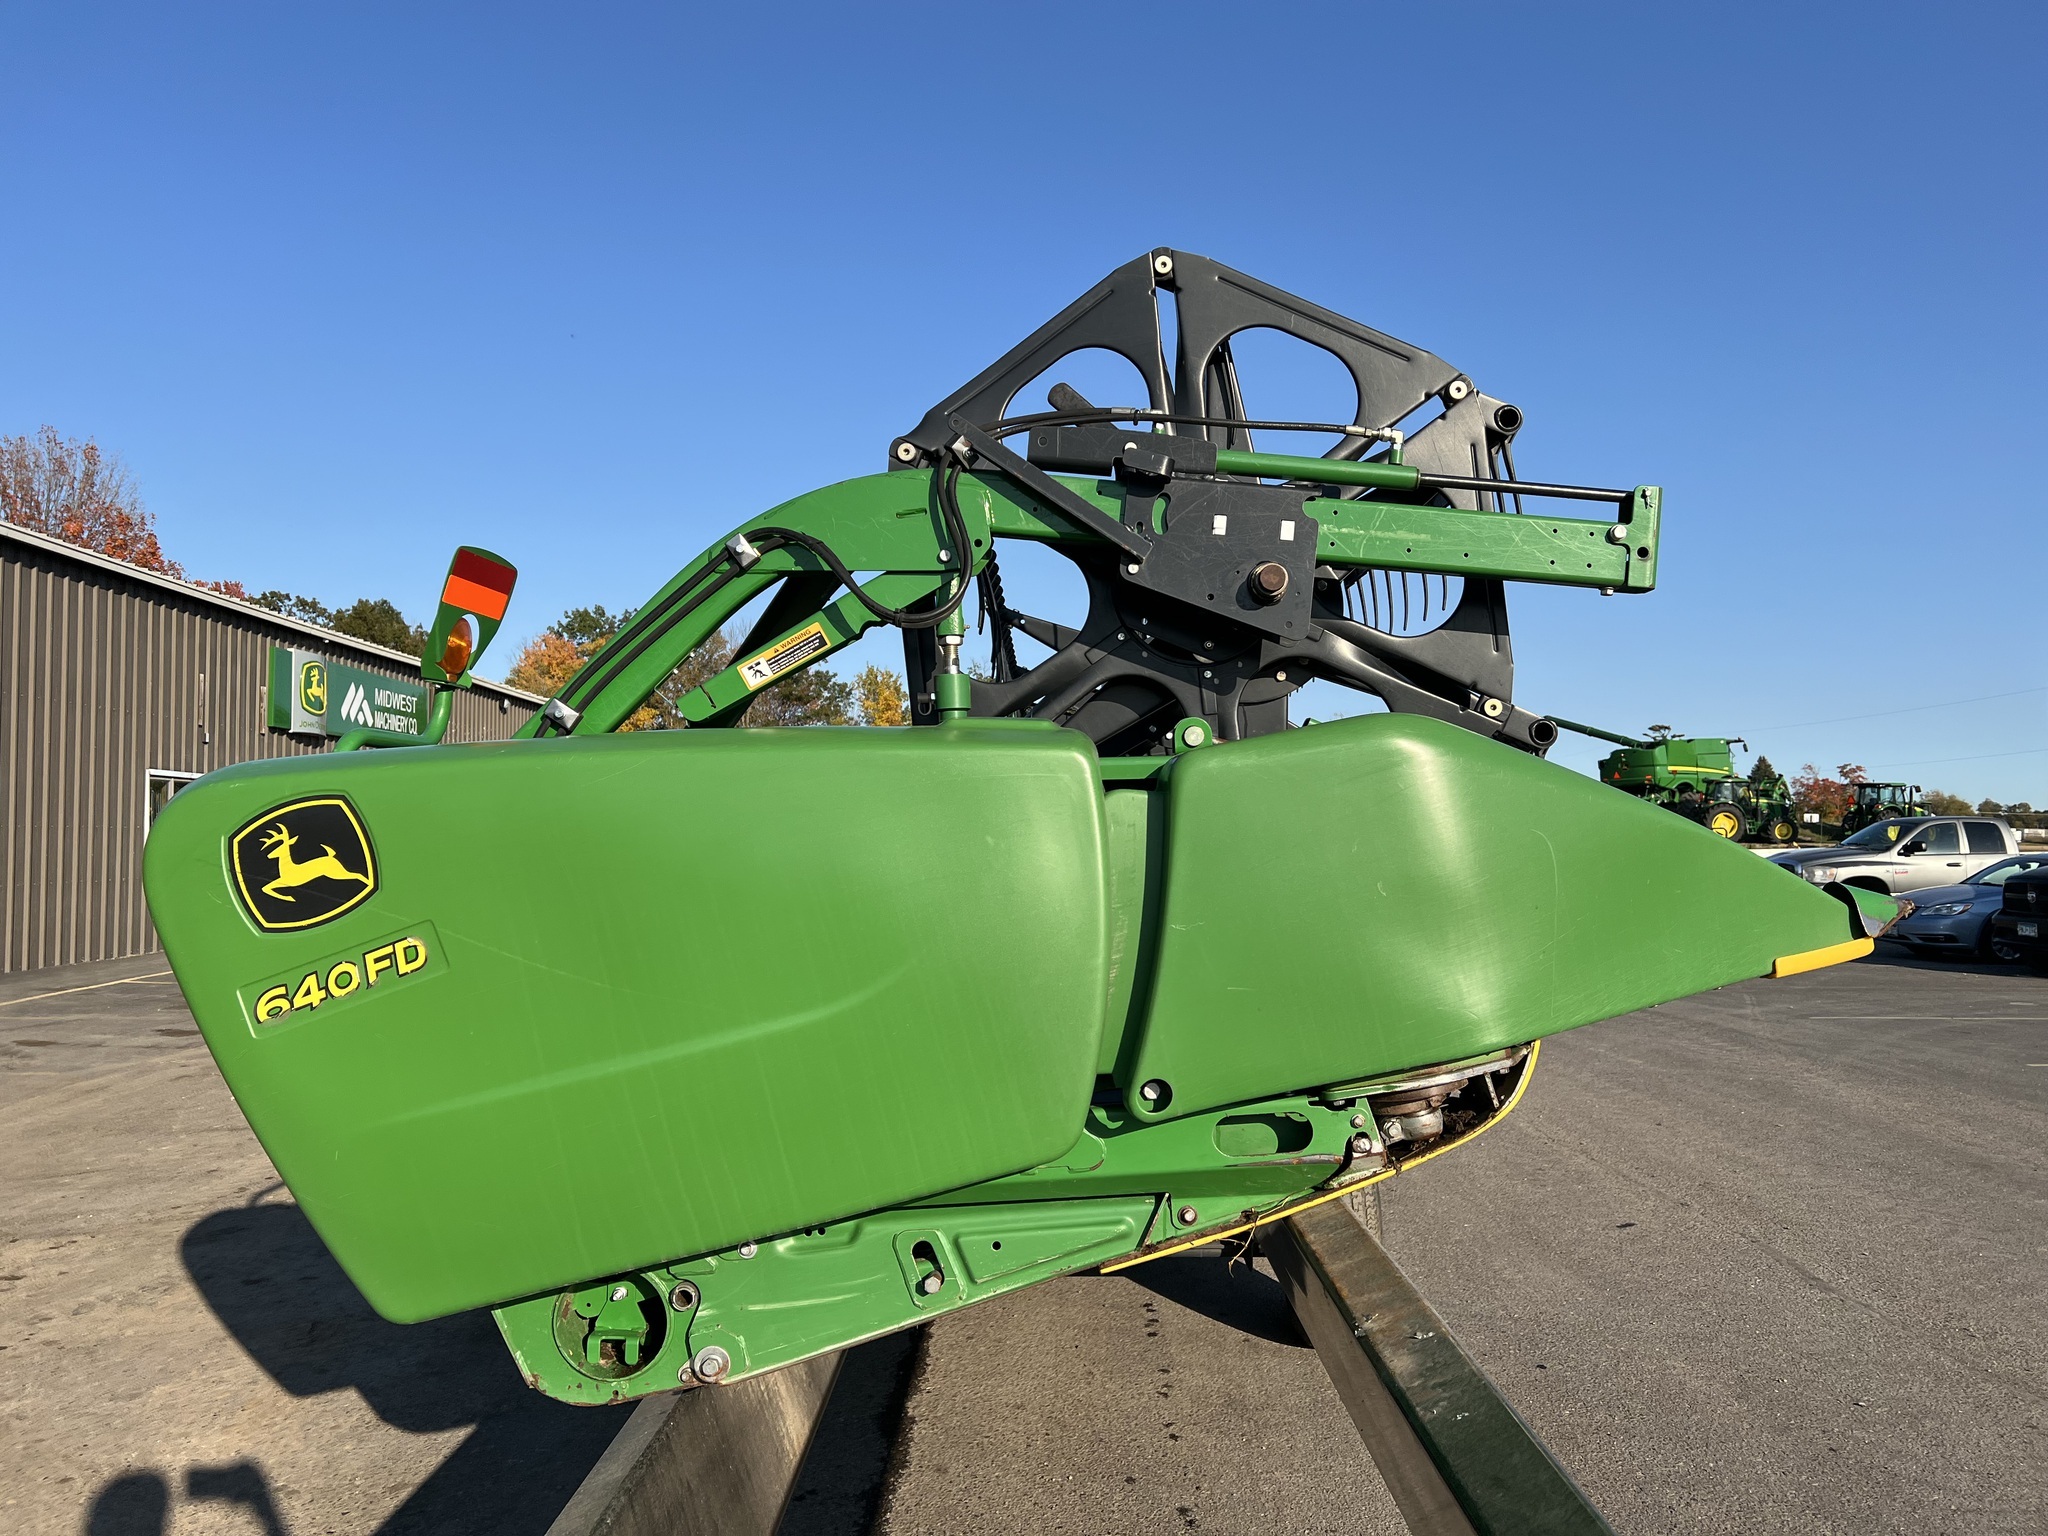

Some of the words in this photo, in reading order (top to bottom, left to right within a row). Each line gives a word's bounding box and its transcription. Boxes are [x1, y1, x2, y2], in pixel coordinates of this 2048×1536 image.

[780, 629, 812, 649] WARNING
[374, 687, 418, 714] MIDWEST
[374, 710, 409, 733] MACHINERY
